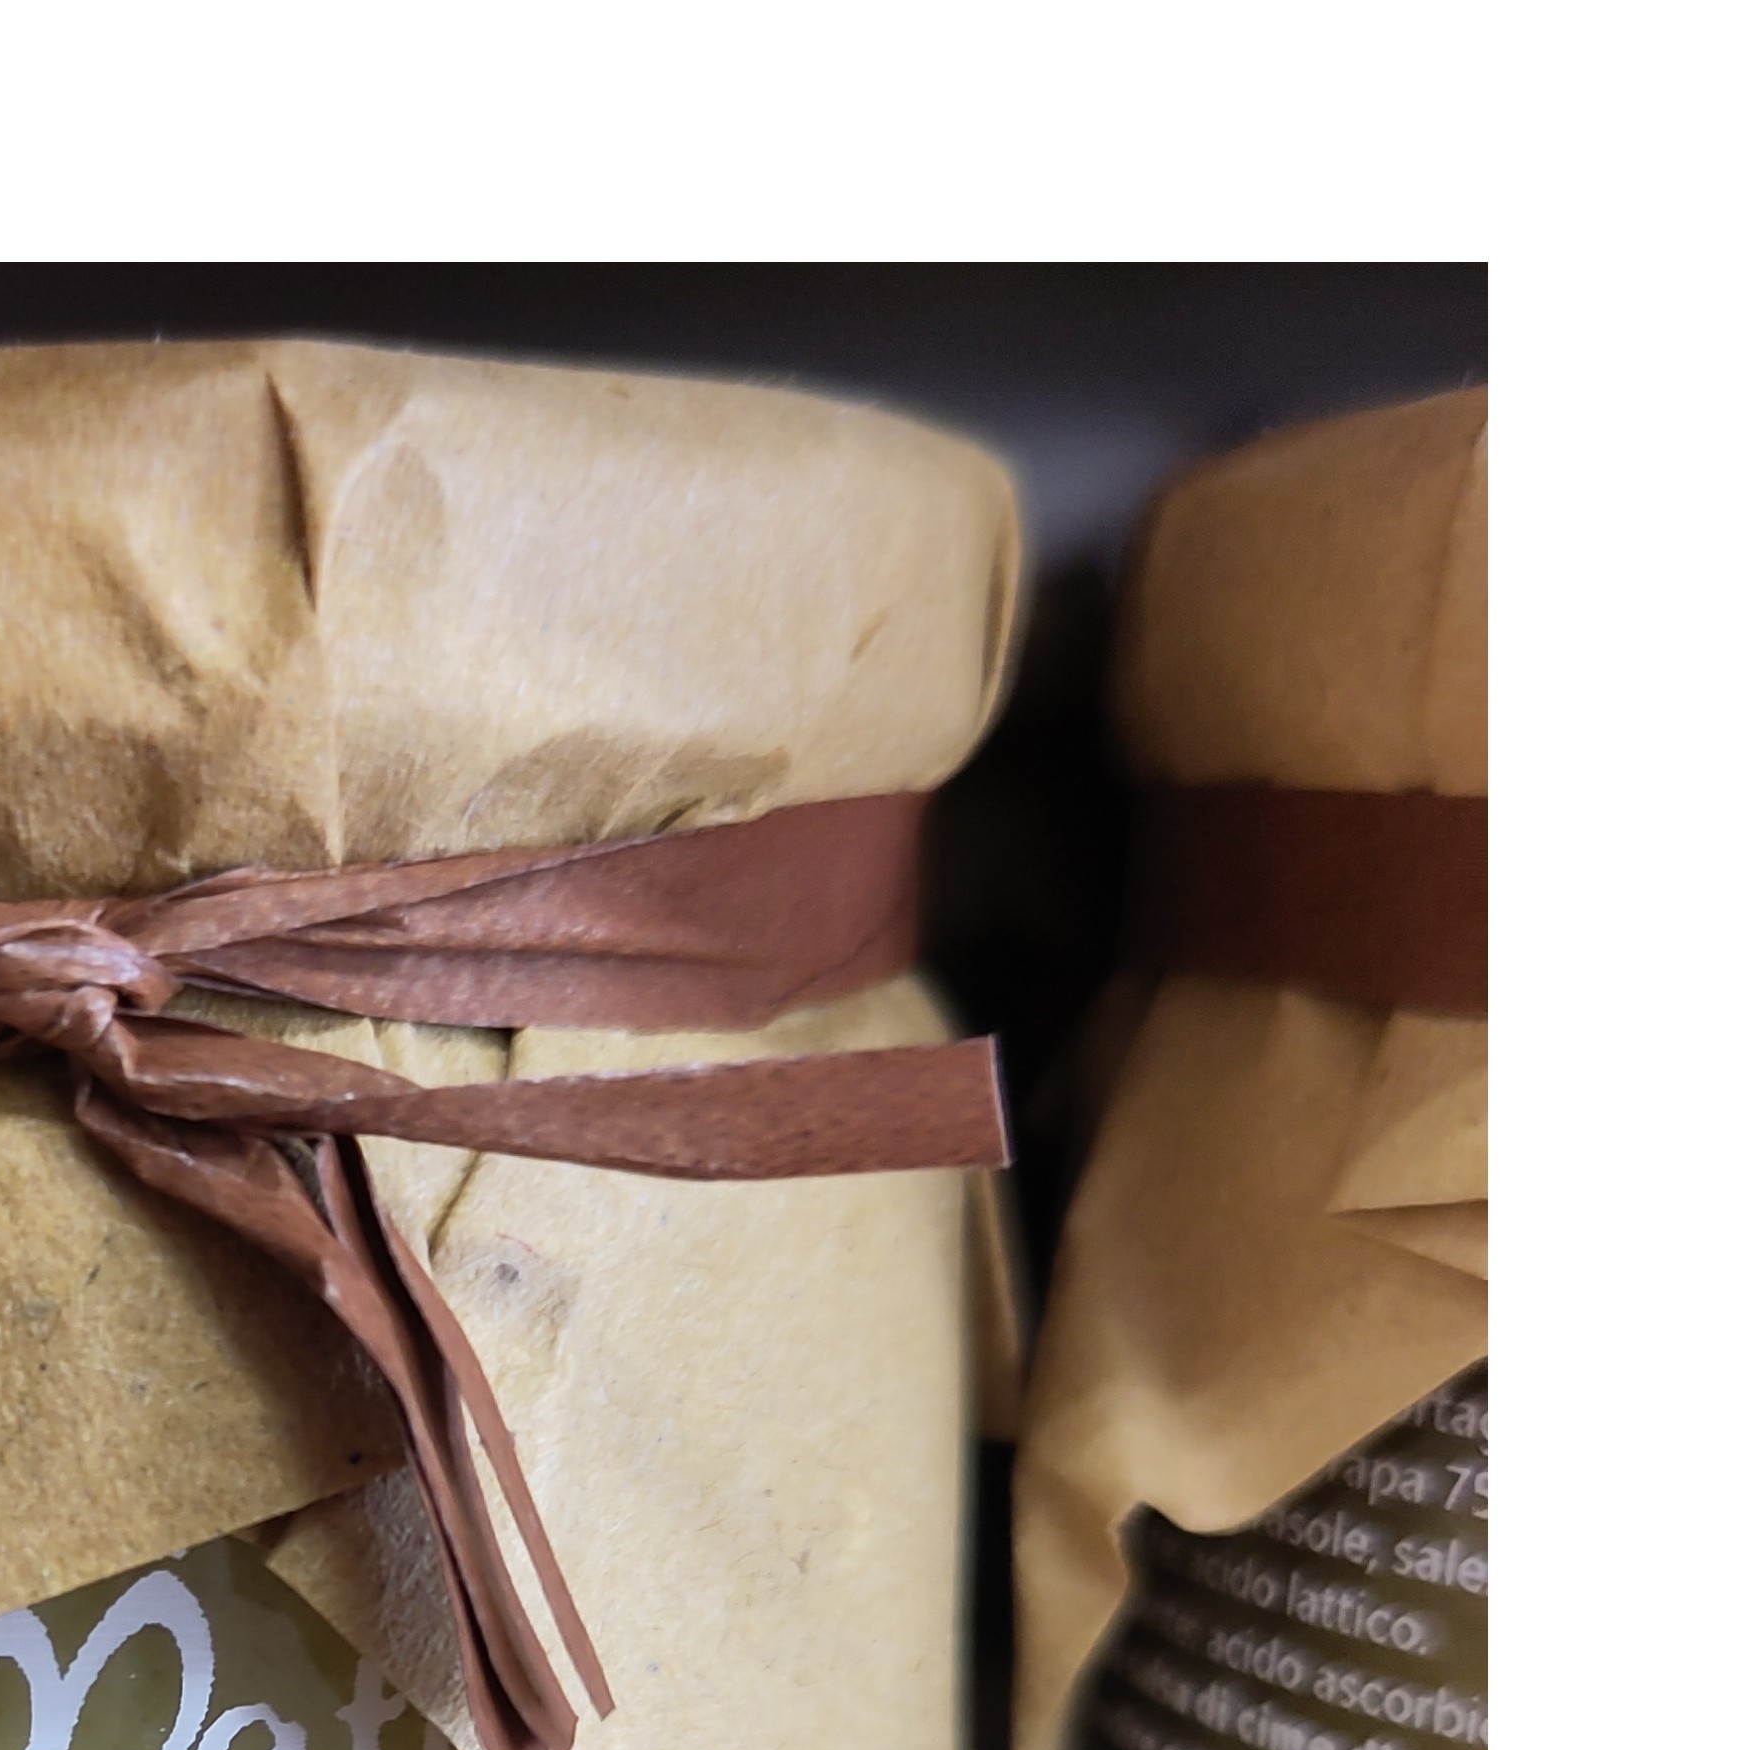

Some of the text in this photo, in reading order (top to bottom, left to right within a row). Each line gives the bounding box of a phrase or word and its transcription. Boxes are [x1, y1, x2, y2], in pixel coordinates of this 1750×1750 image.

[1334, 1449, 1428, 1506] apa
[1286, 1570, 1430, 1654] lattico.
[1206, 1628, 1304, 1690] acido
[1312, 1660, 1488, 1746] ascorbi
